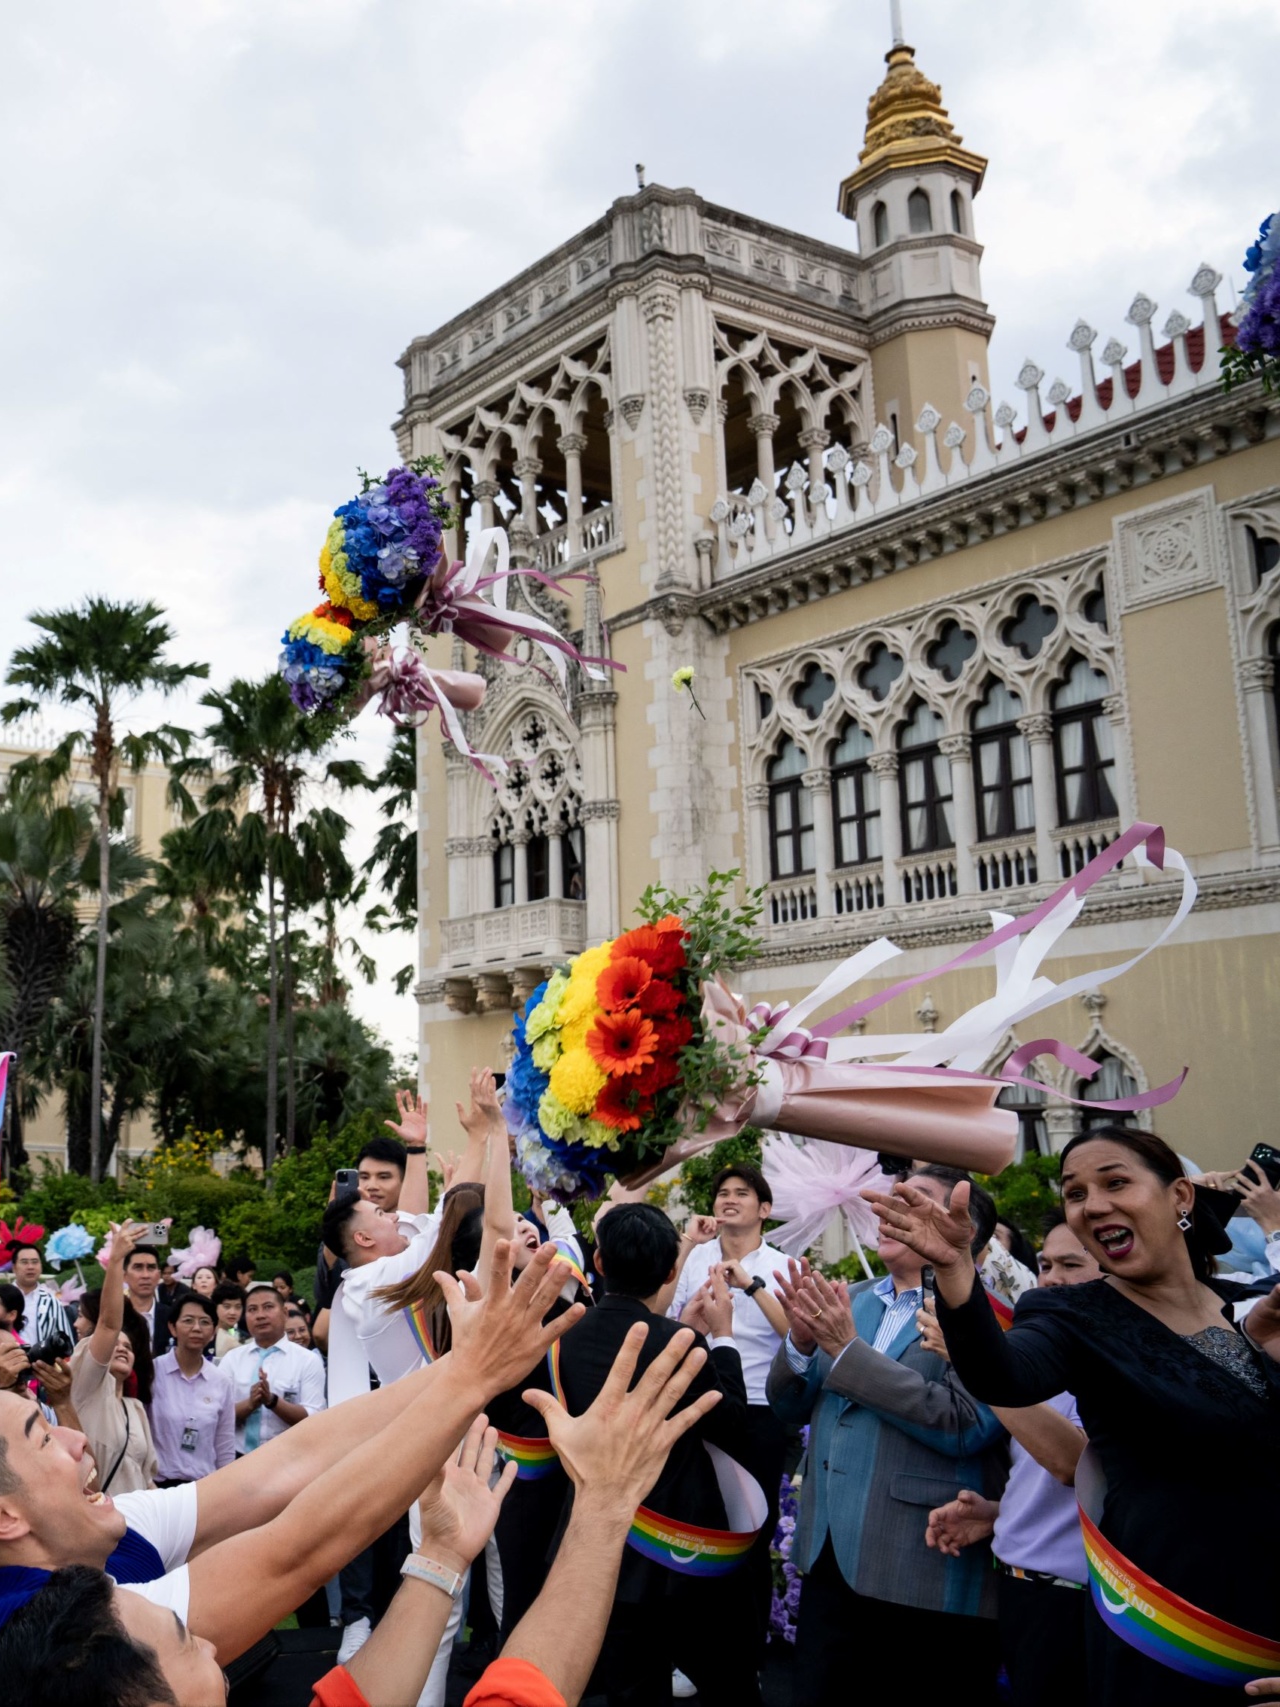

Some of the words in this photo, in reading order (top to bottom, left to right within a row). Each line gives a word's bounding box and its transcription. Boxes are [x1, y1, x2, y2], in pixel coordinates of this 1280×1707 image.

[656, 1530, 718, 1554] THAILAND
[675, 1531, 705, 1543] amazing
[1090, 1548, 1157, 1619] THAILAND
[1103, 1559, 1137, 1592] amazing
